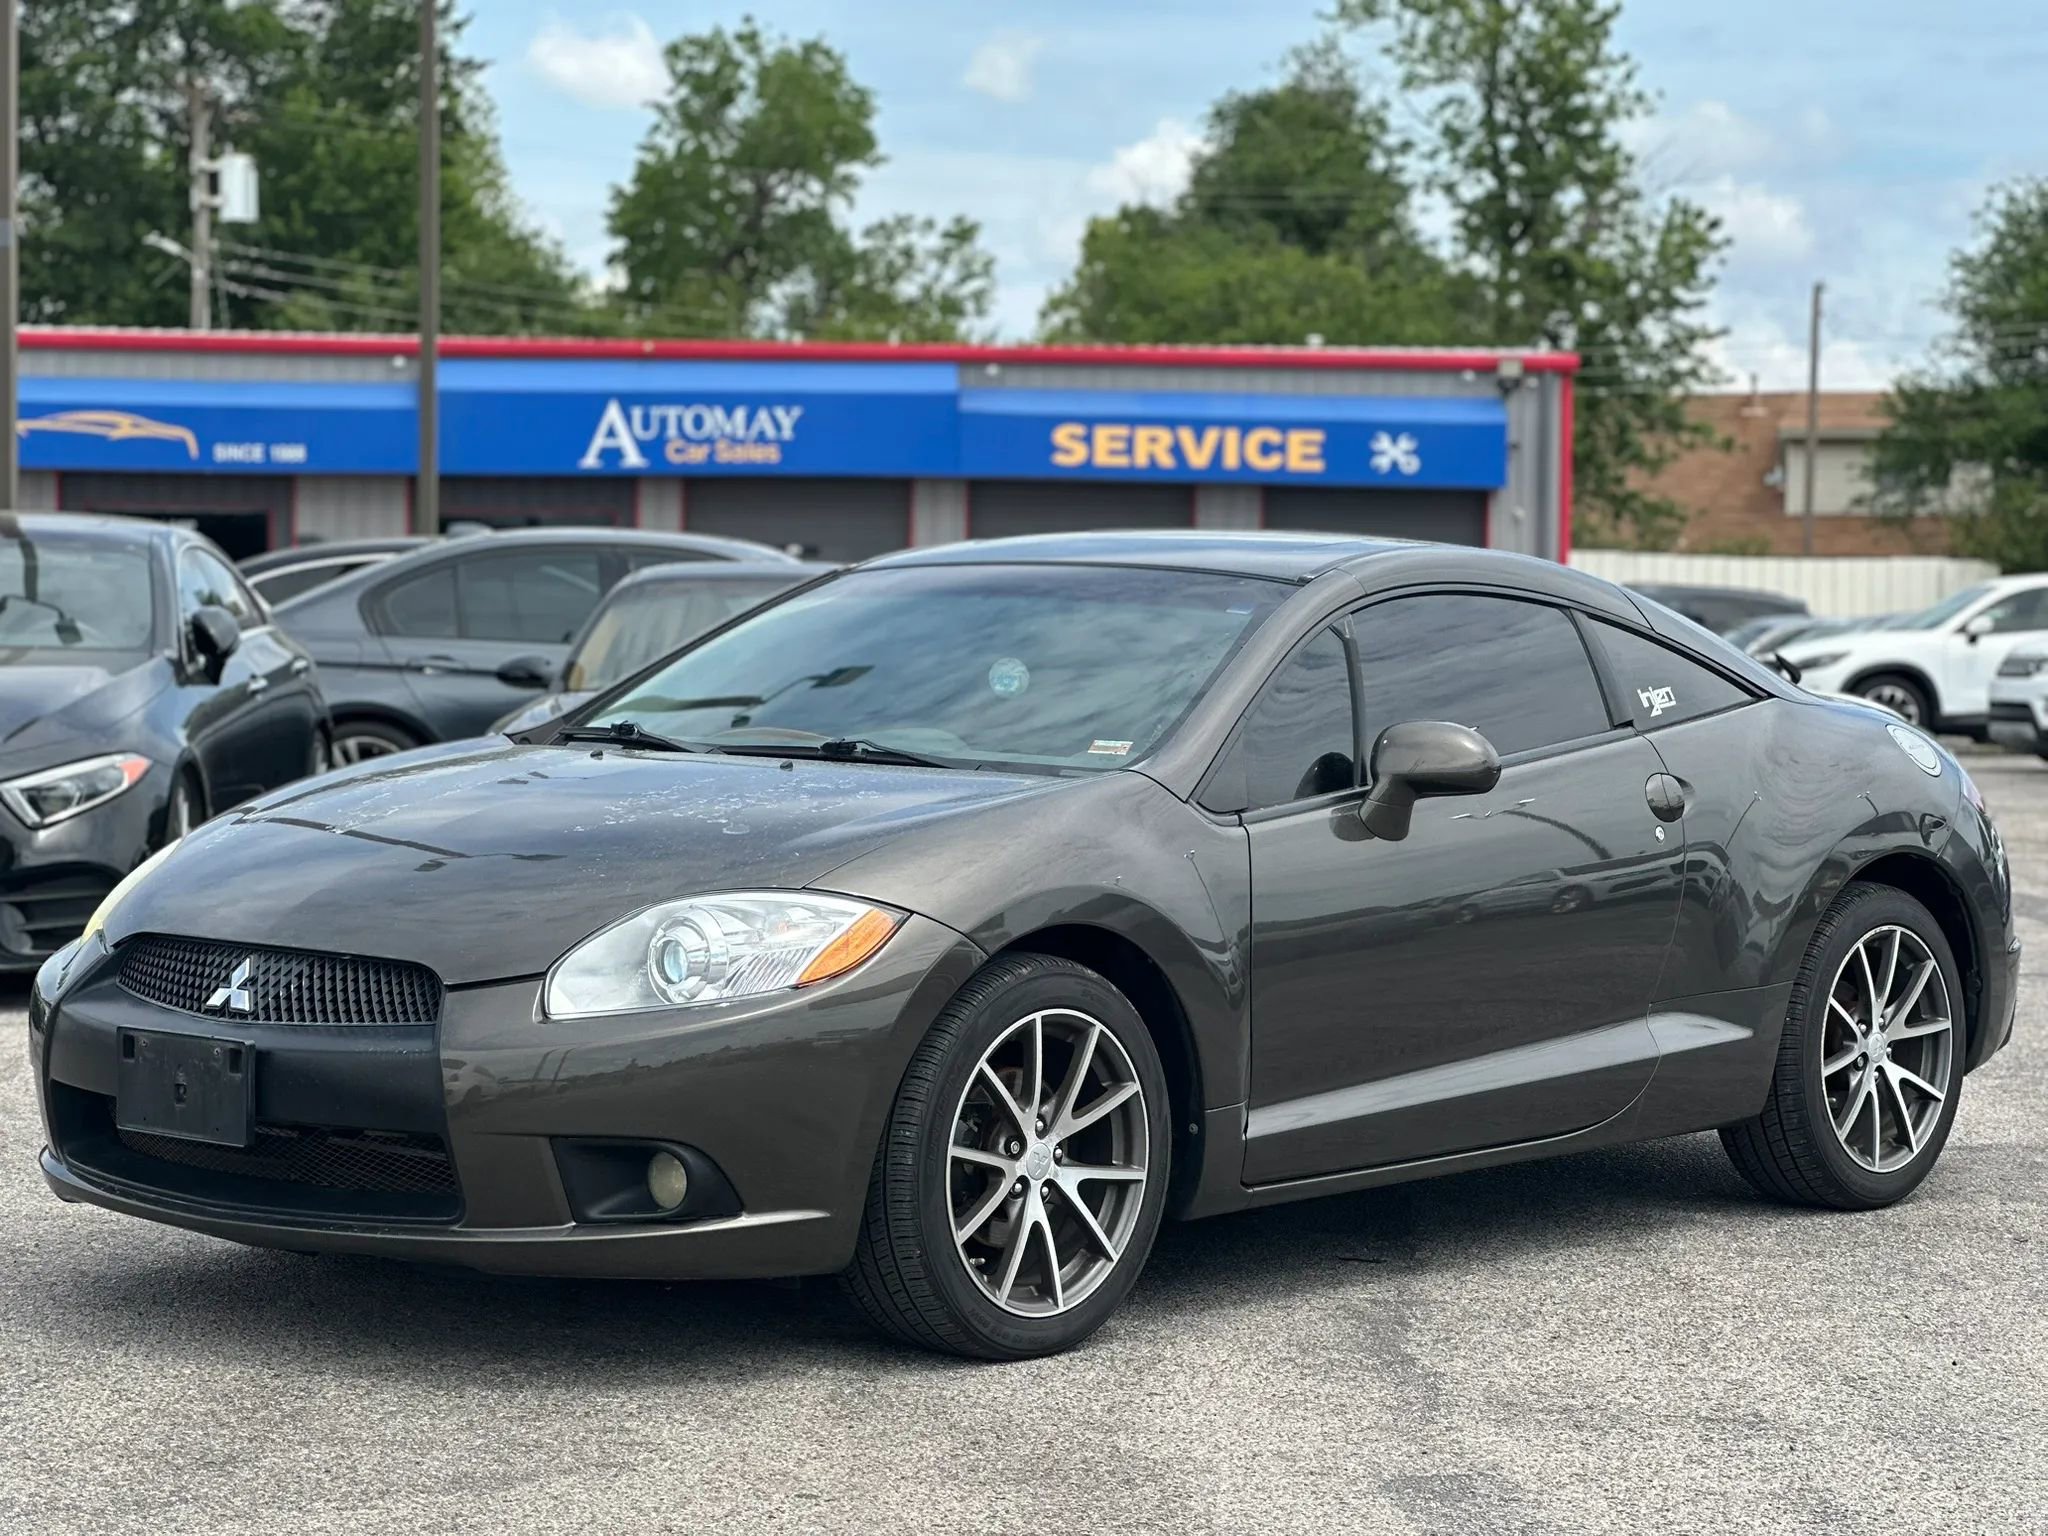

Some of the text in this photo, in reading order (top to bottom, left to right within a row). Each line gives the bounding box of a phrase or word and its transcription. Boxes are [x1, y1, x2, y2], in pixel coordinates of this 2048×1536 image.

[666, 438, 781, 464] Car Sales
[1050, 423, 1326, 473] SERVICE
